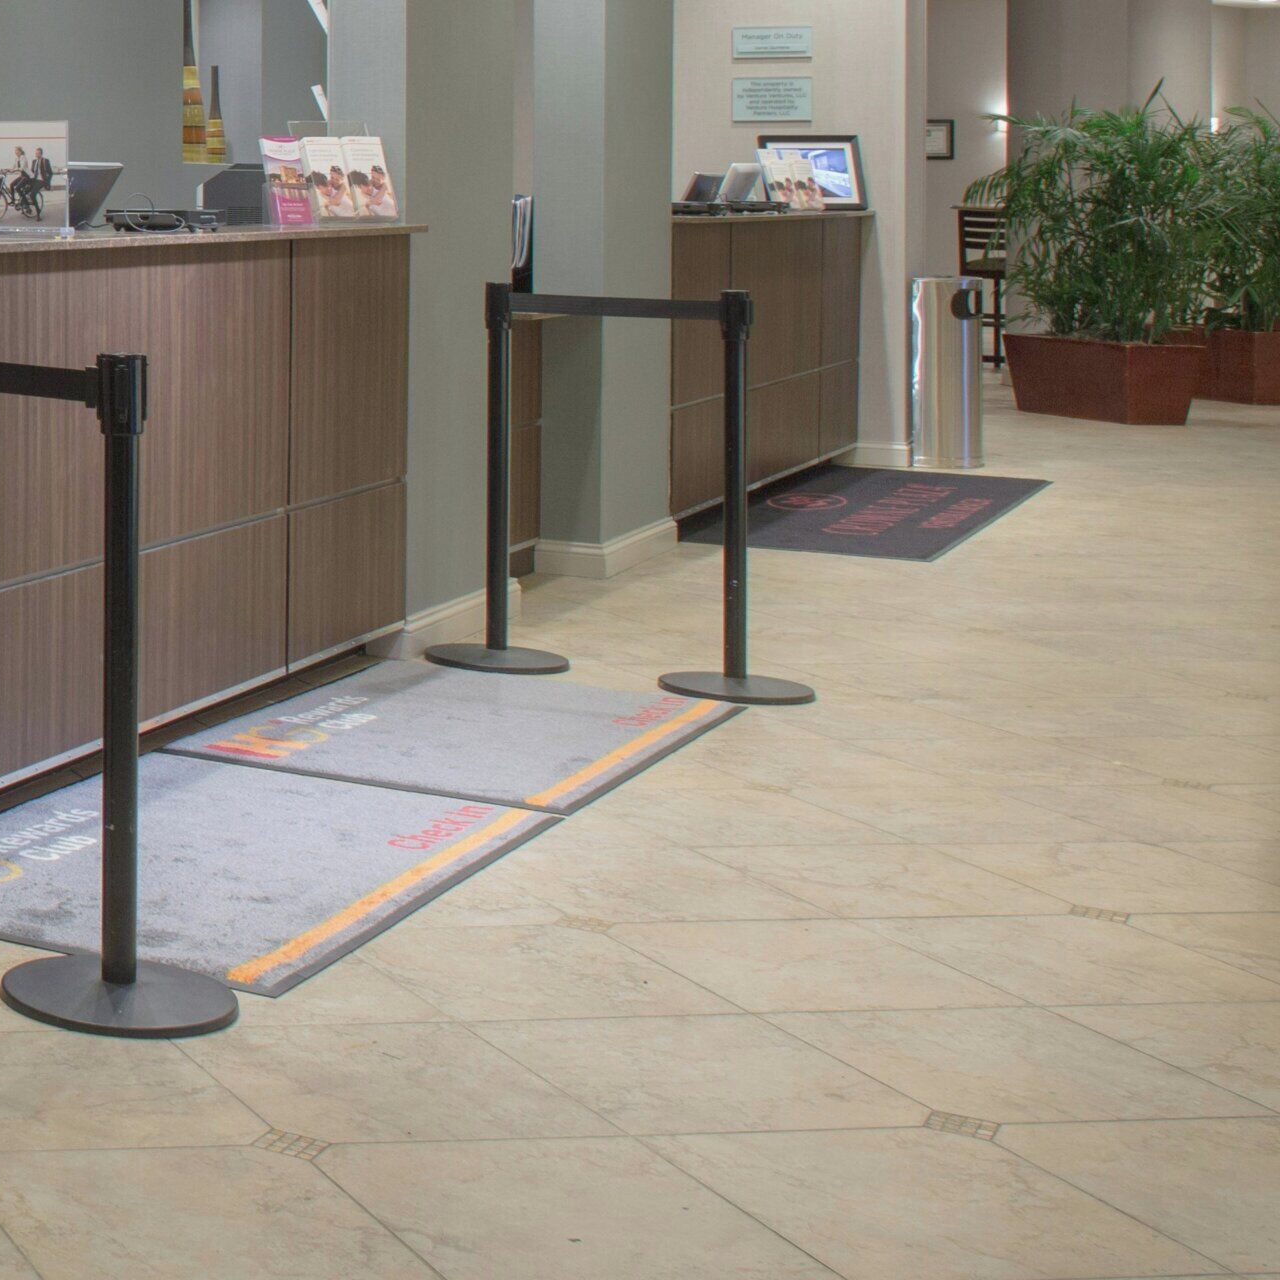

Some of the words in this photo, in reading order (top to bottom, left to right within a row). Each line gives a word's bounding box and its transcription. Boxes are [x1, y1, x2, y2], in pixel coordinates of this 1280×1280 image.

[742, 32, 771, 40] Manager
[786, 31, 802, 39] Duty
[277, 695, 369, 726] Rewards
[317, 713, 378, 730] Club
[203, 725, 328, 760] IHG
[387, 817, 477, 850] Check
[443, 805, 495, 819] in
[19, 835, 98, 861] Club
